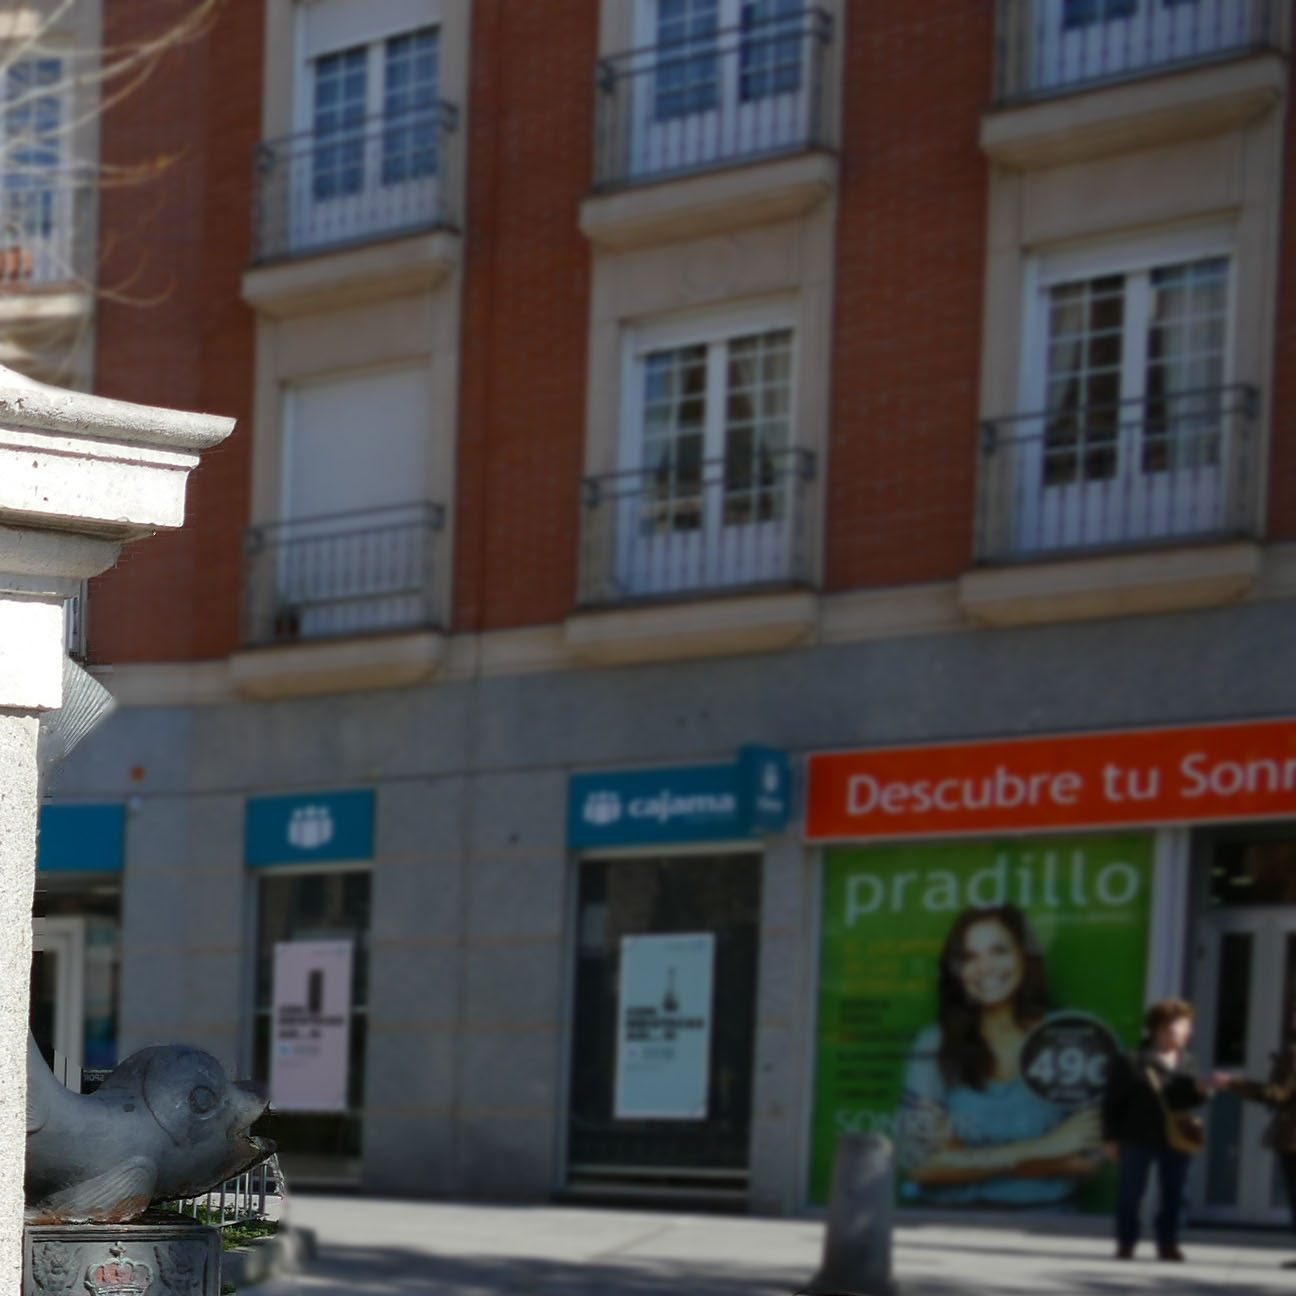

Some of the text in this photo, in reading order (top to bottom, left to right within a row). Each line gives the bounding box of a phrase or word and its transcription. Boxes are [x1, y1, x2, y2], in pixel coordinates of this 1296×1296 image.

[845, 765, 1082, 815] Descubre
[1103, 763, 1160, 800] tu
[845, 850, 1141, 927] pradillo
